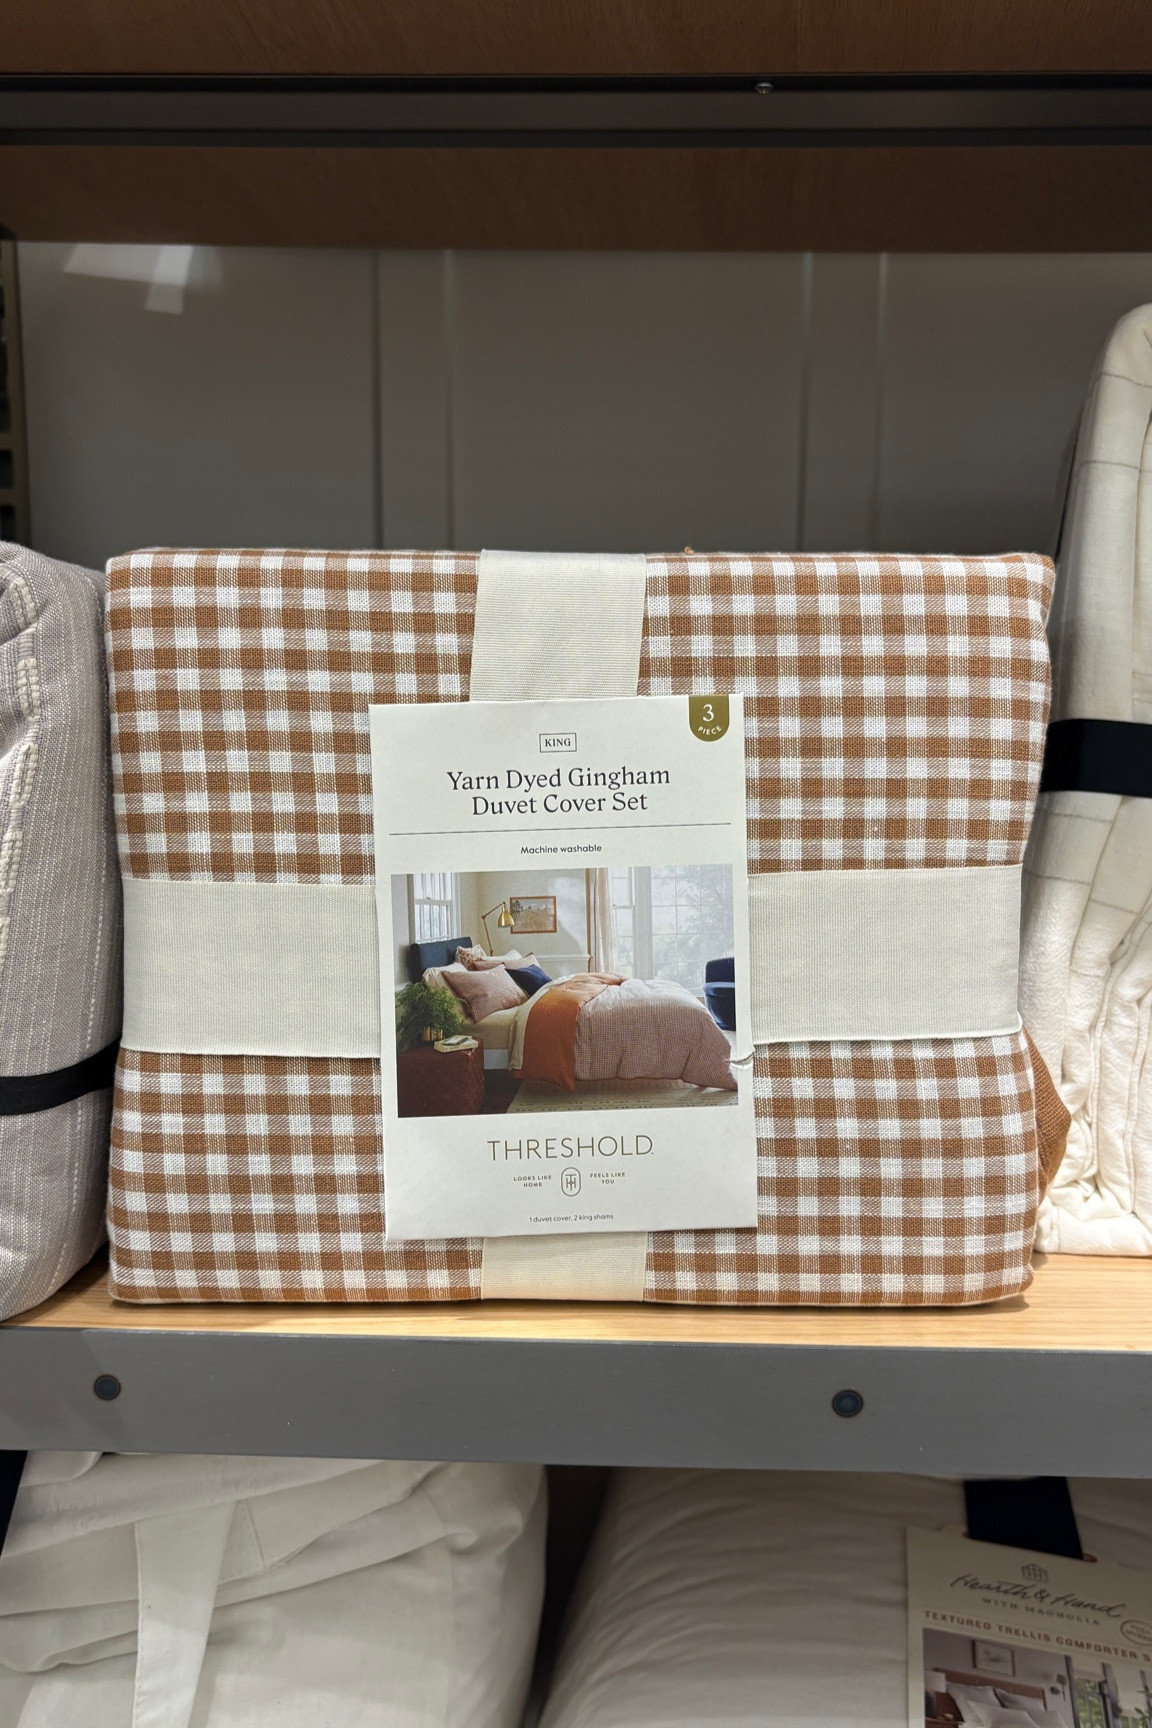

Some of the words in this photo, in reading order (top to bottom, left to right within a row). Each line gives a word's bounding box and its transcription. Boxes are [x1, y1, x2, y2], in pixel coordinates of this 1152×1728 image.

[702, 703, 715, 722] 3
[544, 737, 571, 748] KING
[697, 725, 722, 736] PIECE
[446, 771, 500, 791] Yarn
[505, 767, 562, 793] Dyed
[567, 765, 671, 791] Gingham
[472, 796, 538, 816] Duvet
[543, 793, 607, 814] Cover
[611, 791, 649, 812] Set
[520, 845, 559, 855] Machine
[560, 843, 603, 854] washable
[487, 1135, 653, 1161] THRESHOLD
[553, 1214, 573, 1222] cover,
[573, 1214, 578, 1222] 2
[579, 1214, 593, 1222] king
[593, 1213, 614, 1221] shams
[949, 1572, 1036, 1600] Hearth
[1033, 1587, 1051, 1604] &
[1049, 1592, 1127, 1618] Hand
[981, 1596, 1018, 1610] WITH
[1024, 1604, 1100, 1626] MAGNOLIA
[924, 1610, 992, 1631] TEXTURED
[995, 1623, 1051, 1643] TRELLIS
[1055, 1635, 1138, 1661] COMFORTER
